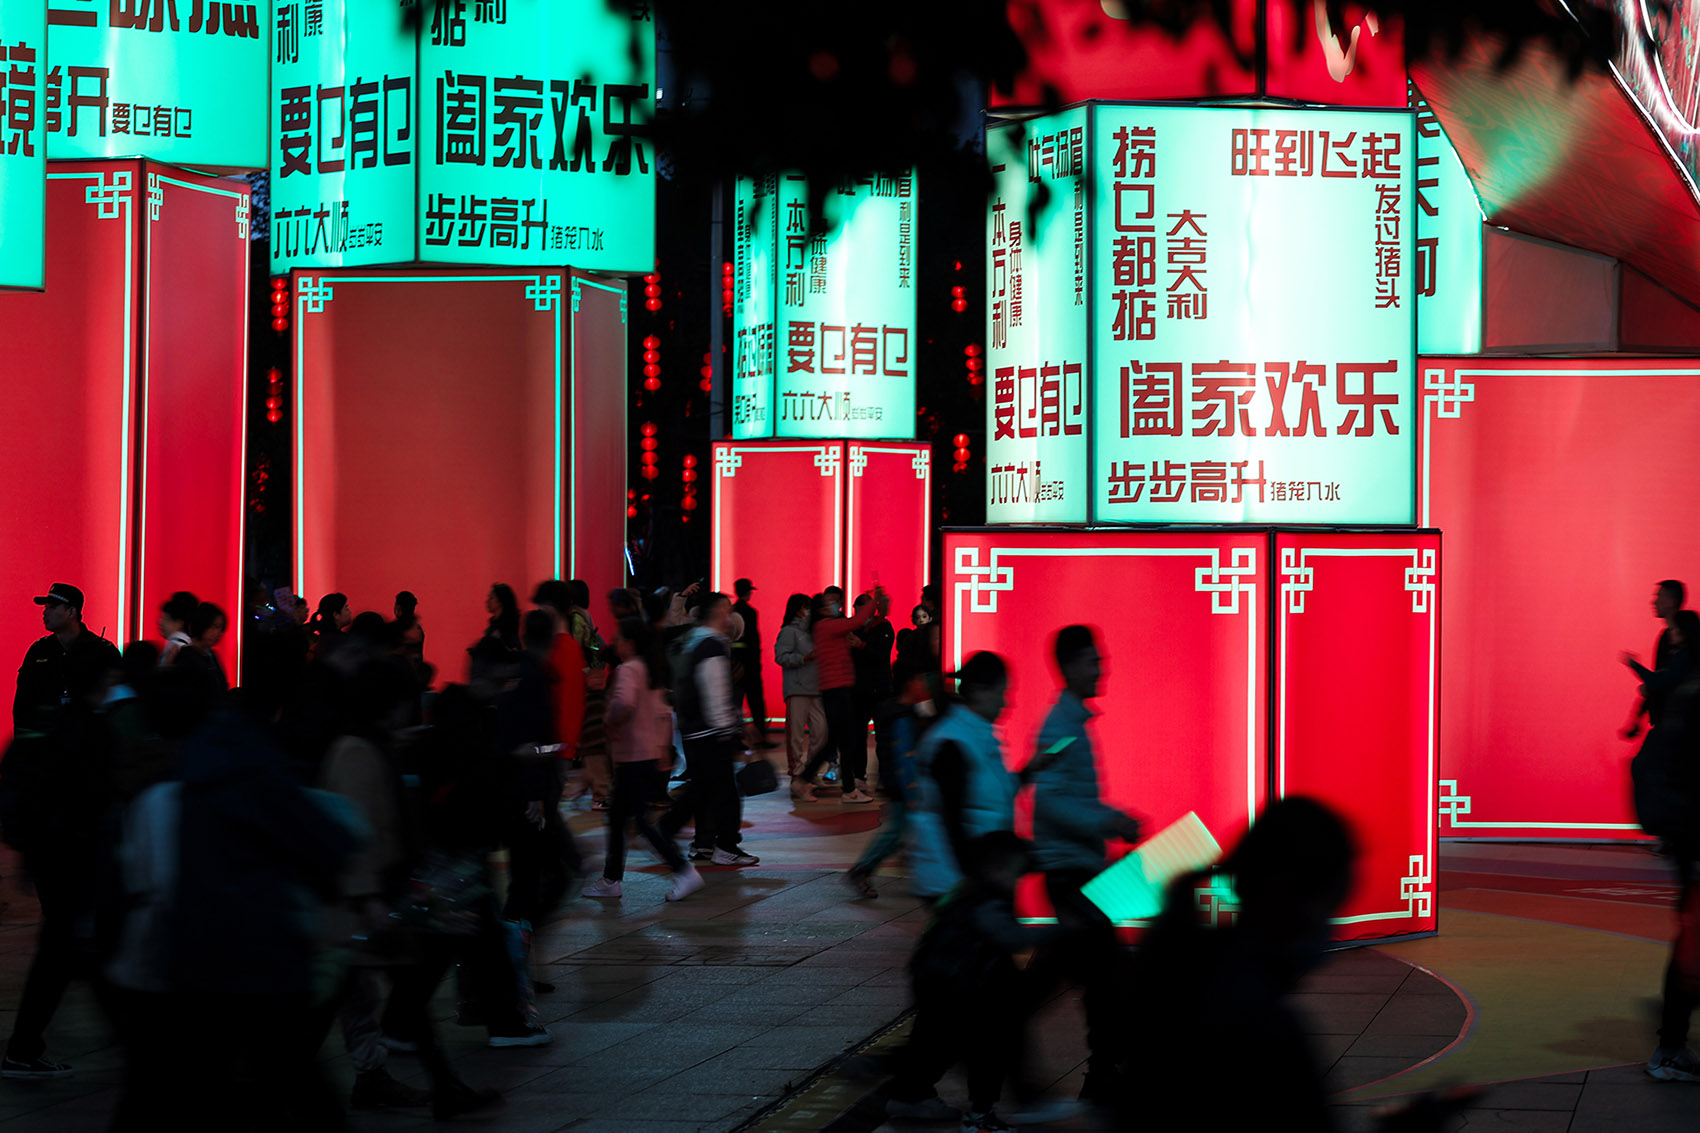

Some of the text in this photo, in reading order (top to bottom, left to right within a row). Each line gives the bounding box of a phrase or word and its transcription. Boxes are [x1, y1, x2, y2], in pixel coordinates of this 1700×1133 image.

[436, 70, 650, 175] 阖家欢乐
[1232, 129, 1400, 179] 旺到飞起
[426, 193, 548, 250] 步步高升
[1375, 184, 1400, 308] 发过猪头
[1166, 210, 1207, 319] 大吉大利
[1120, 360, 1399, 438] 阖家欢乐
[1108, 460, 1266, 504] 步步高升
